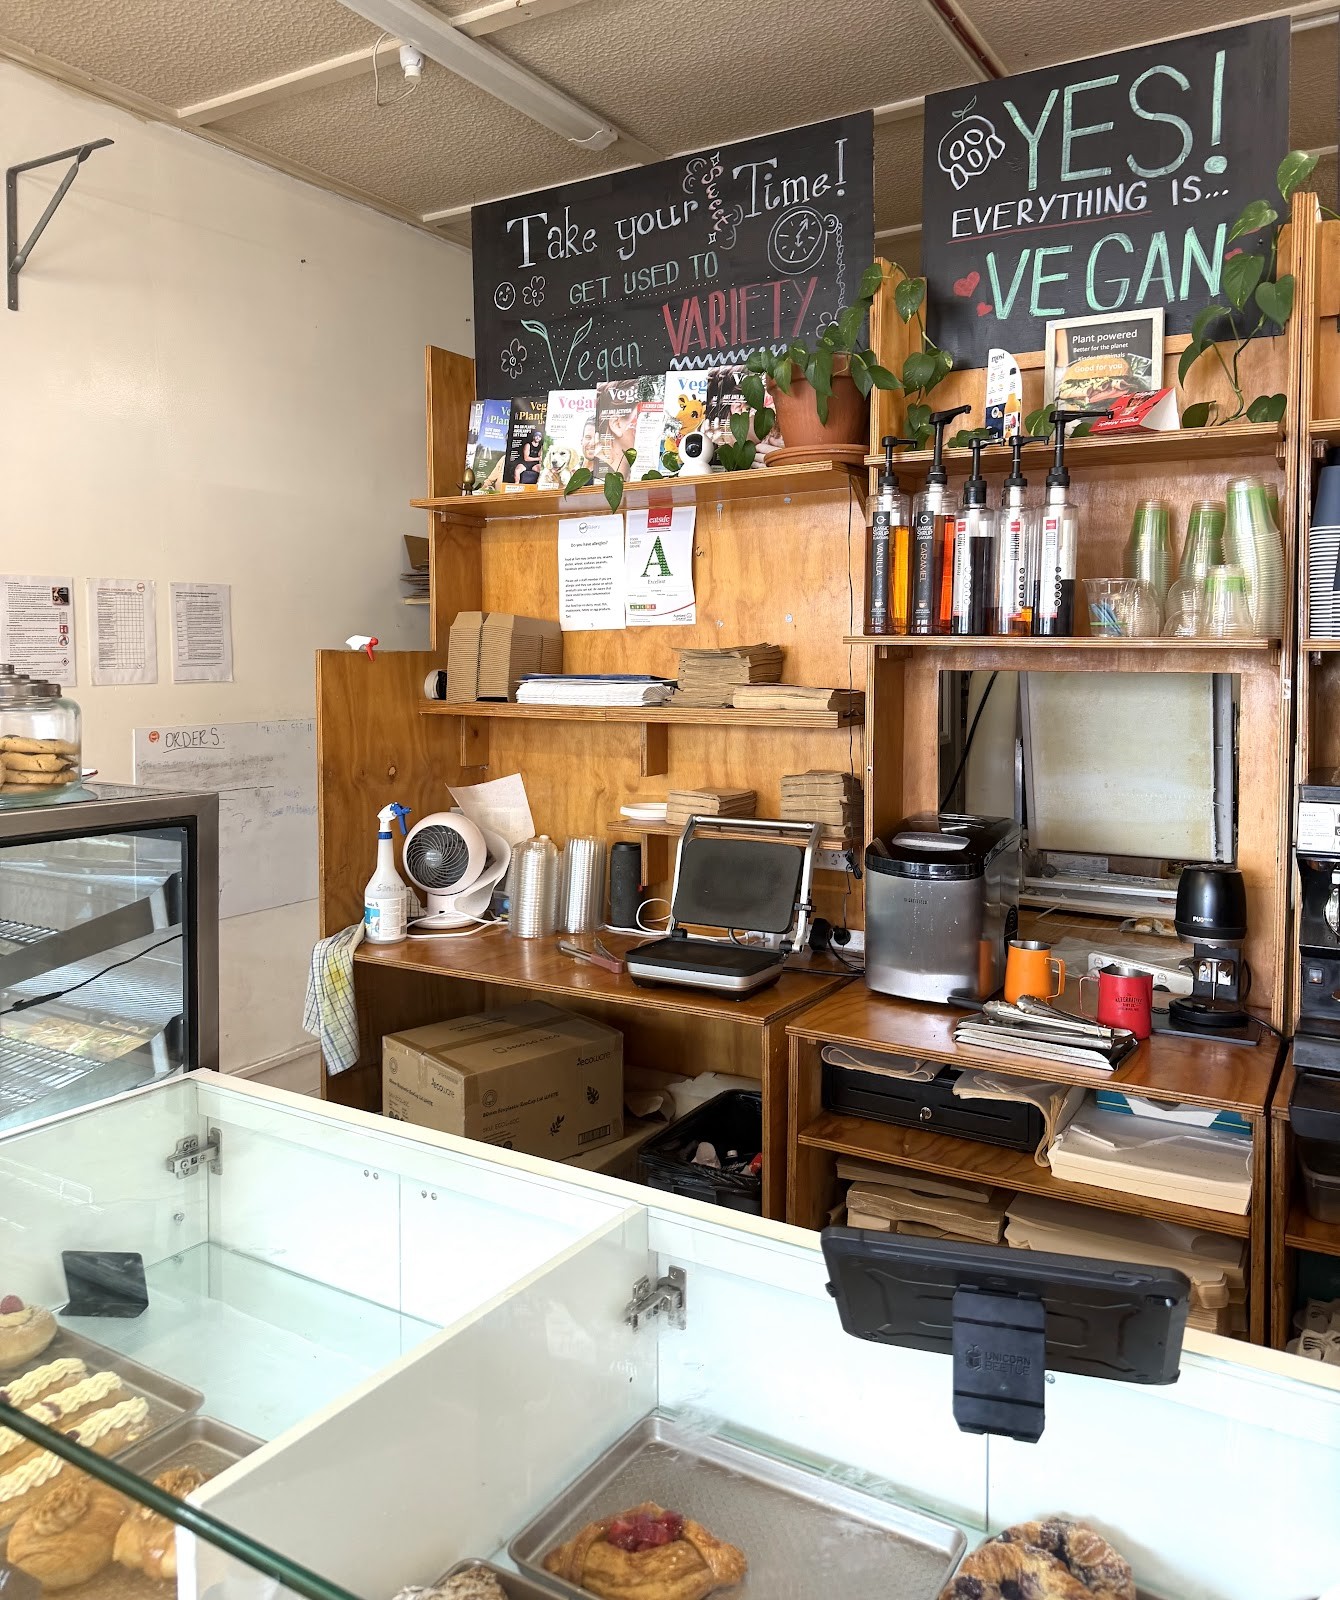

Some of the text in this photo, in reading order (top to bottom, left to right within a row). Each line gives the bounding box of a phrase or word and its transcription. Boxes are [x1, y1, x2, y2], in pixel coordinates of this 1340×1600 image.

[1003, 50, 1228, 191] YES!
[506, 138, 849, 269] Take your Time!
[951, 181, 1148, 238] EVERYTHING
[569, 250, 719, 305] GET USED TO
[986, 223, 1227, 320] VEGAN
[662, 277, 819, 357] VARIETY
[1072, 328, 1138, 344] Plant powered
[520, 317, 643, 386] Vegan
[640, 535, 673, 577] A
[875, 543, 884, 576] VANILLA
[919, 542, 928, 583] CARAMEL
[985, 1351, 1031, 1366] UNICORN
[985, 1360, 1031, 1376] BEETLE
